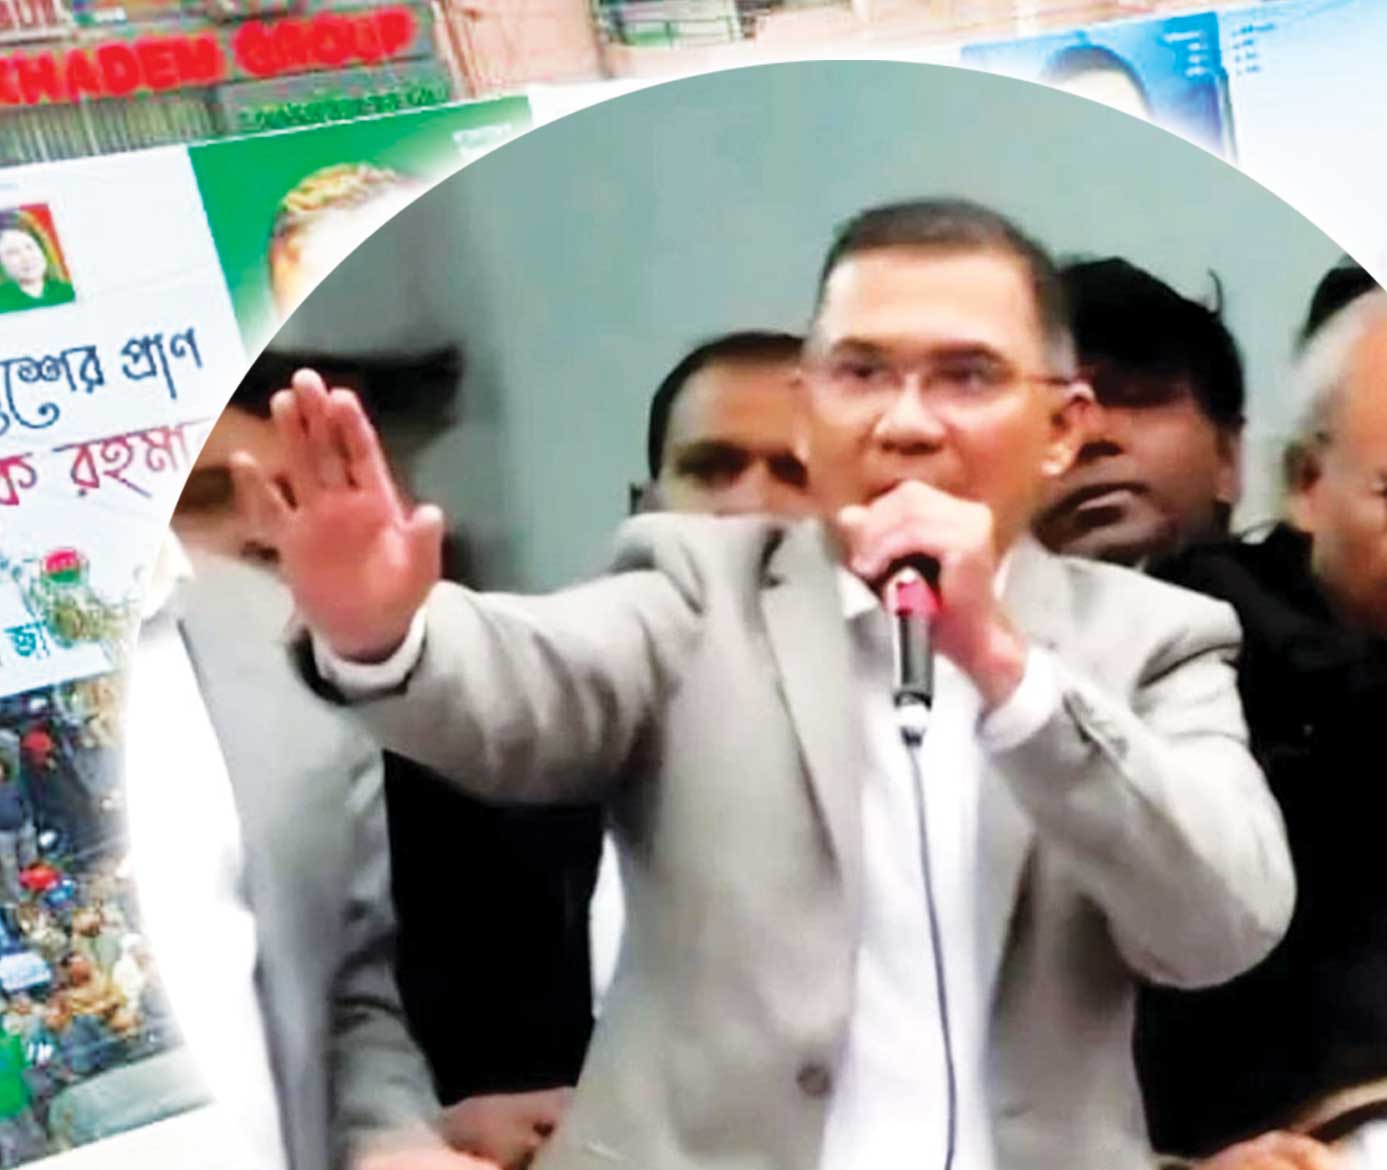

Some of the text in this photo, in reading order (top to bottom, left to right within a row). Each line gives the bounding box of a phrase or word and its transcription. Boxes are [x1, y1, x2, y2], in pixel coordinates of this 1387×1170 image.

[230, 5, 418, 77] GROUP
[121, 327, 202, 400] প্রাণ
[53, 417, 212, 497] রহমা
